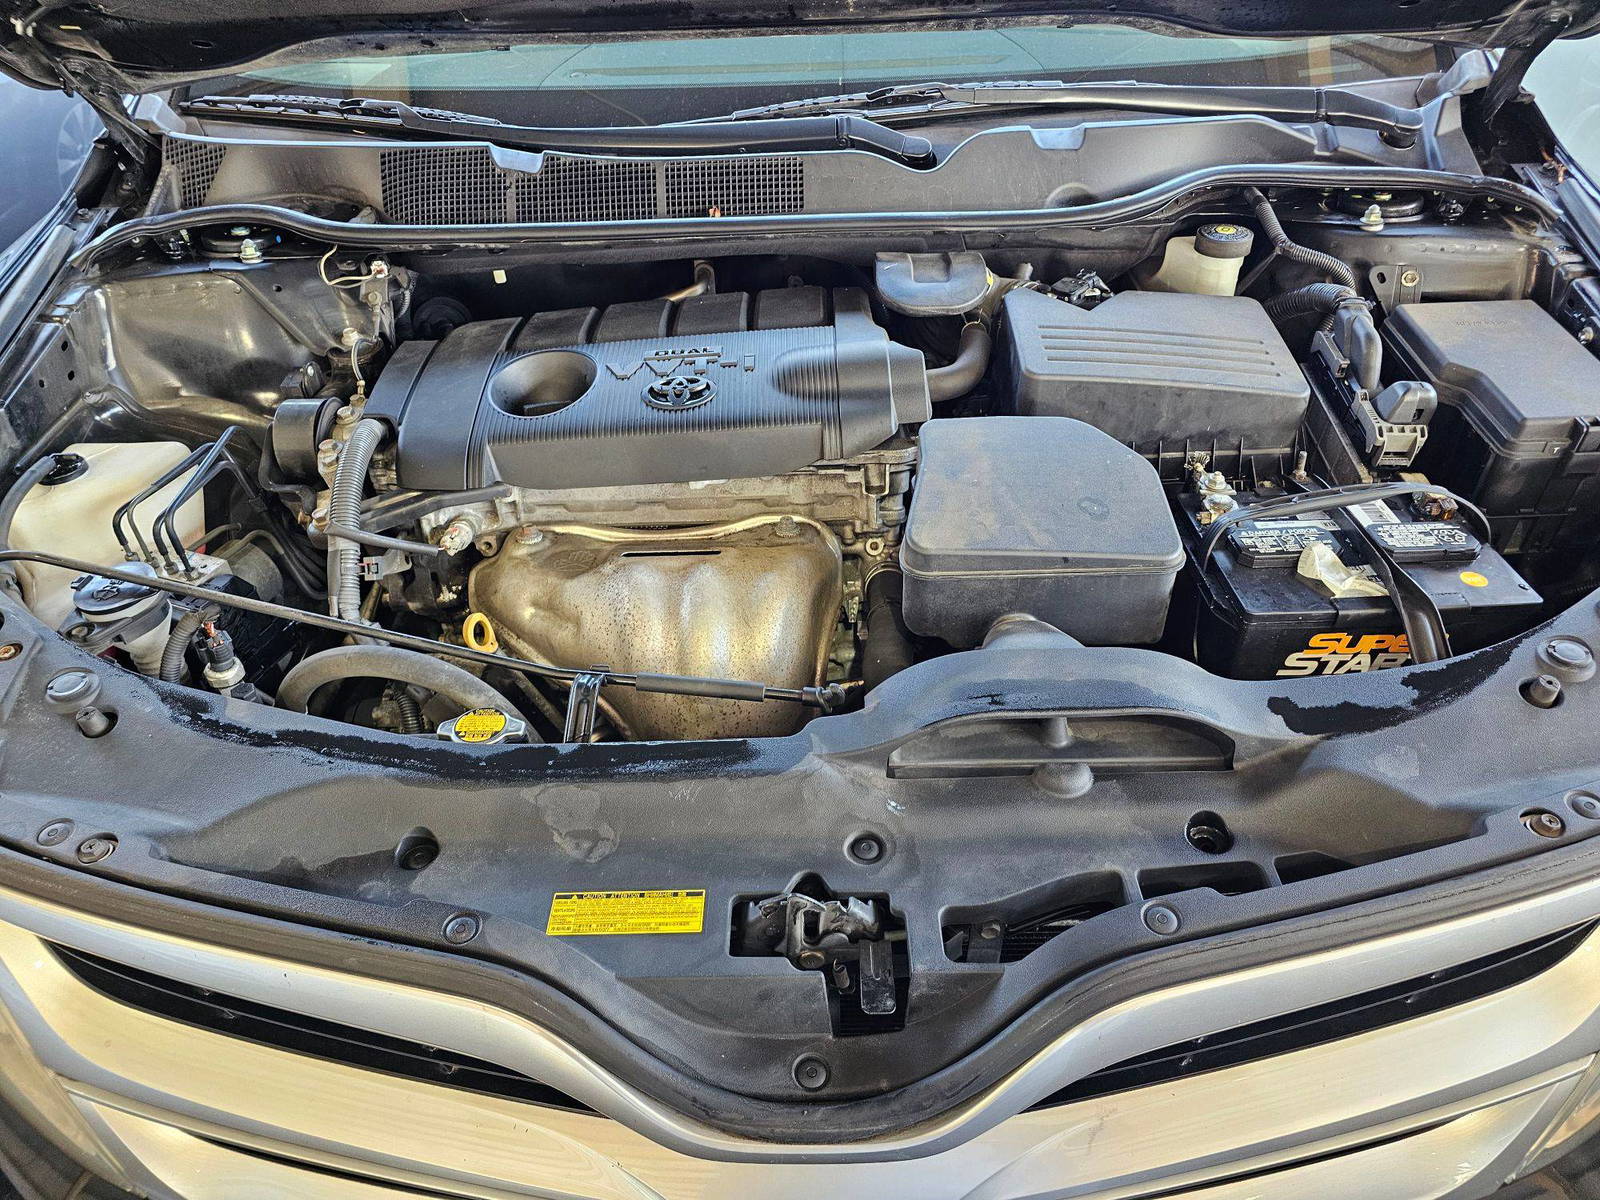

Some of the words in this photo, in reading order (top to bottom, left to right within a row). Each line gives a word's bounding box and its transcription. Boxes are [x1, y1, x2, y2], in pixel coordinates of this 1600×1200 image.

[653, 347, 715, 357] DUAL
[1302, 632, 1410, 655] SUPE
[1276, 652, 1411, 676] STAR
